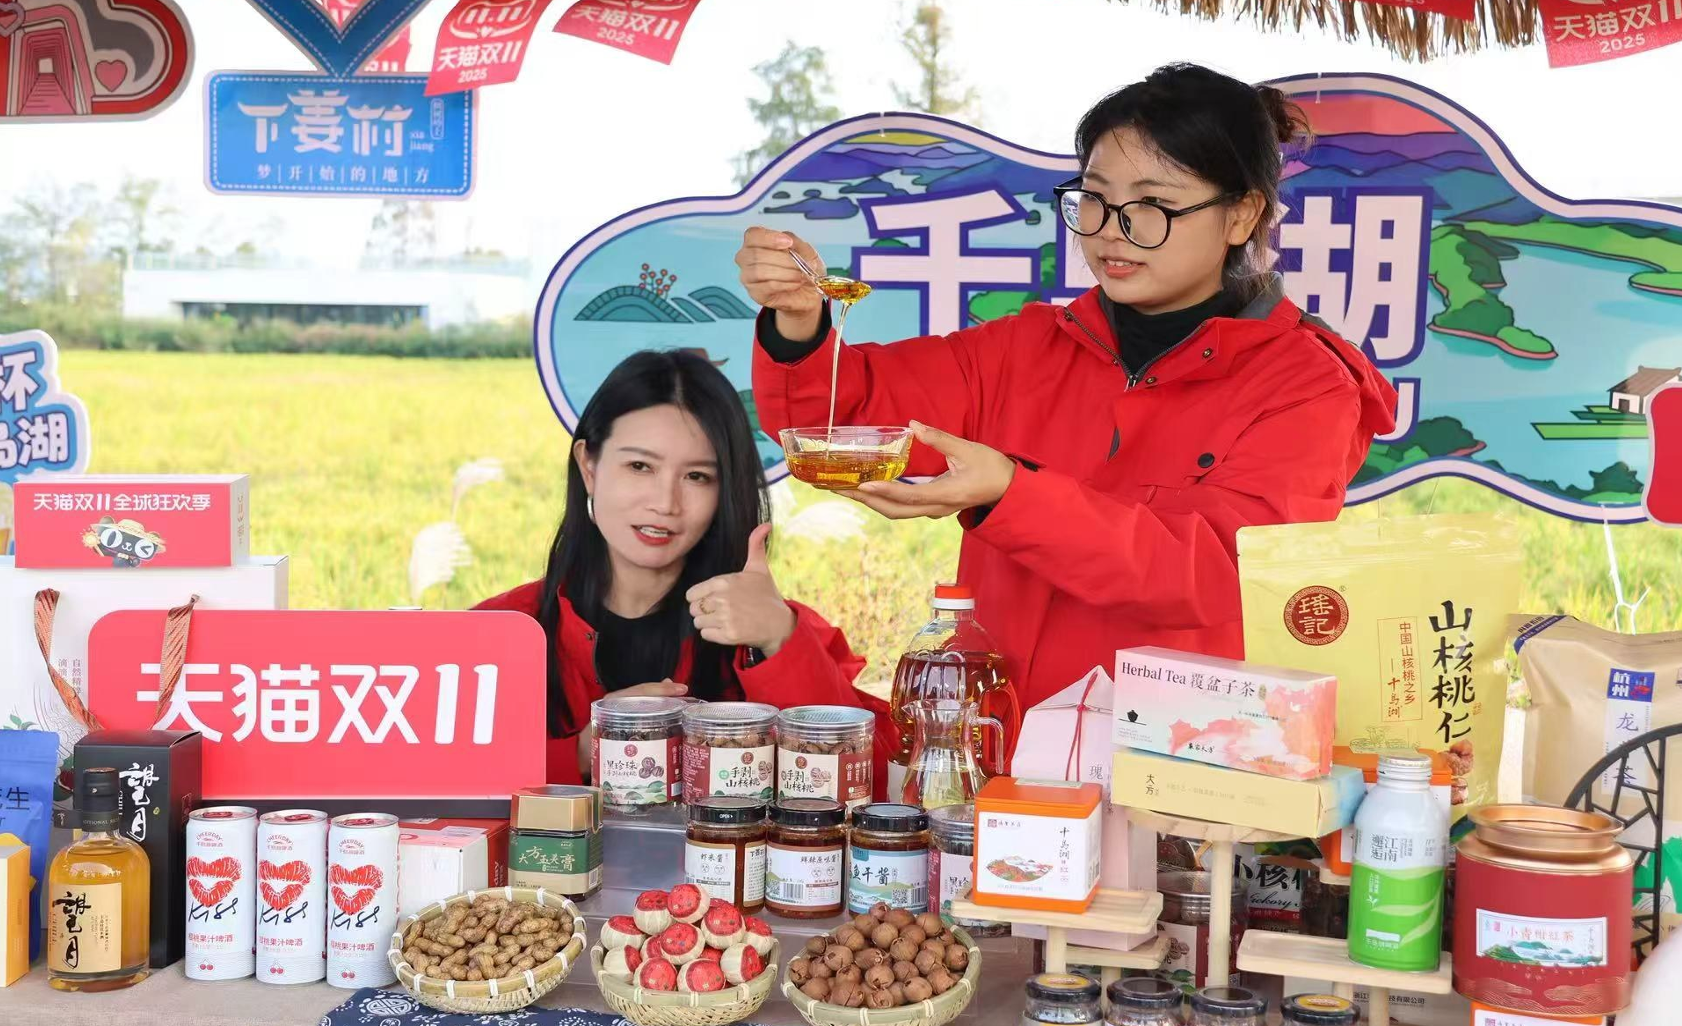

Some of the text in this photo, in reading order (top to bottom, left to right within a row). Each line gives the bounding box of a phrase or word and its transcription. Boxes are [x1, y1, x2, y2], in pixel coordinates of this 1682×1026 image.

[571, 5, 680, 41] 天猫双11
[597, 27, 635, 46] 2025
[1553, 2, 1682, 42] 天猫双11
[437, 40, 523, 72] 天猫双11
[1601, 34, 1646, 54] 2025
[457, 68, 488, 84] 2025
[237, 89, 413, 156] 下姜村
[33, 492, 212, 512] 天猫双11全球狂欢季
[1121, 661, 1256, 698] Herbal Tea 覆盆子茶
[1399, 621, 1416, 705] 中国山核桃之乡
[1428, 599, 1477, 745] 山核桃仁
[1611, 671, 1631, 698] 杭州
[138, 663, 498, 745] 天猫双11
